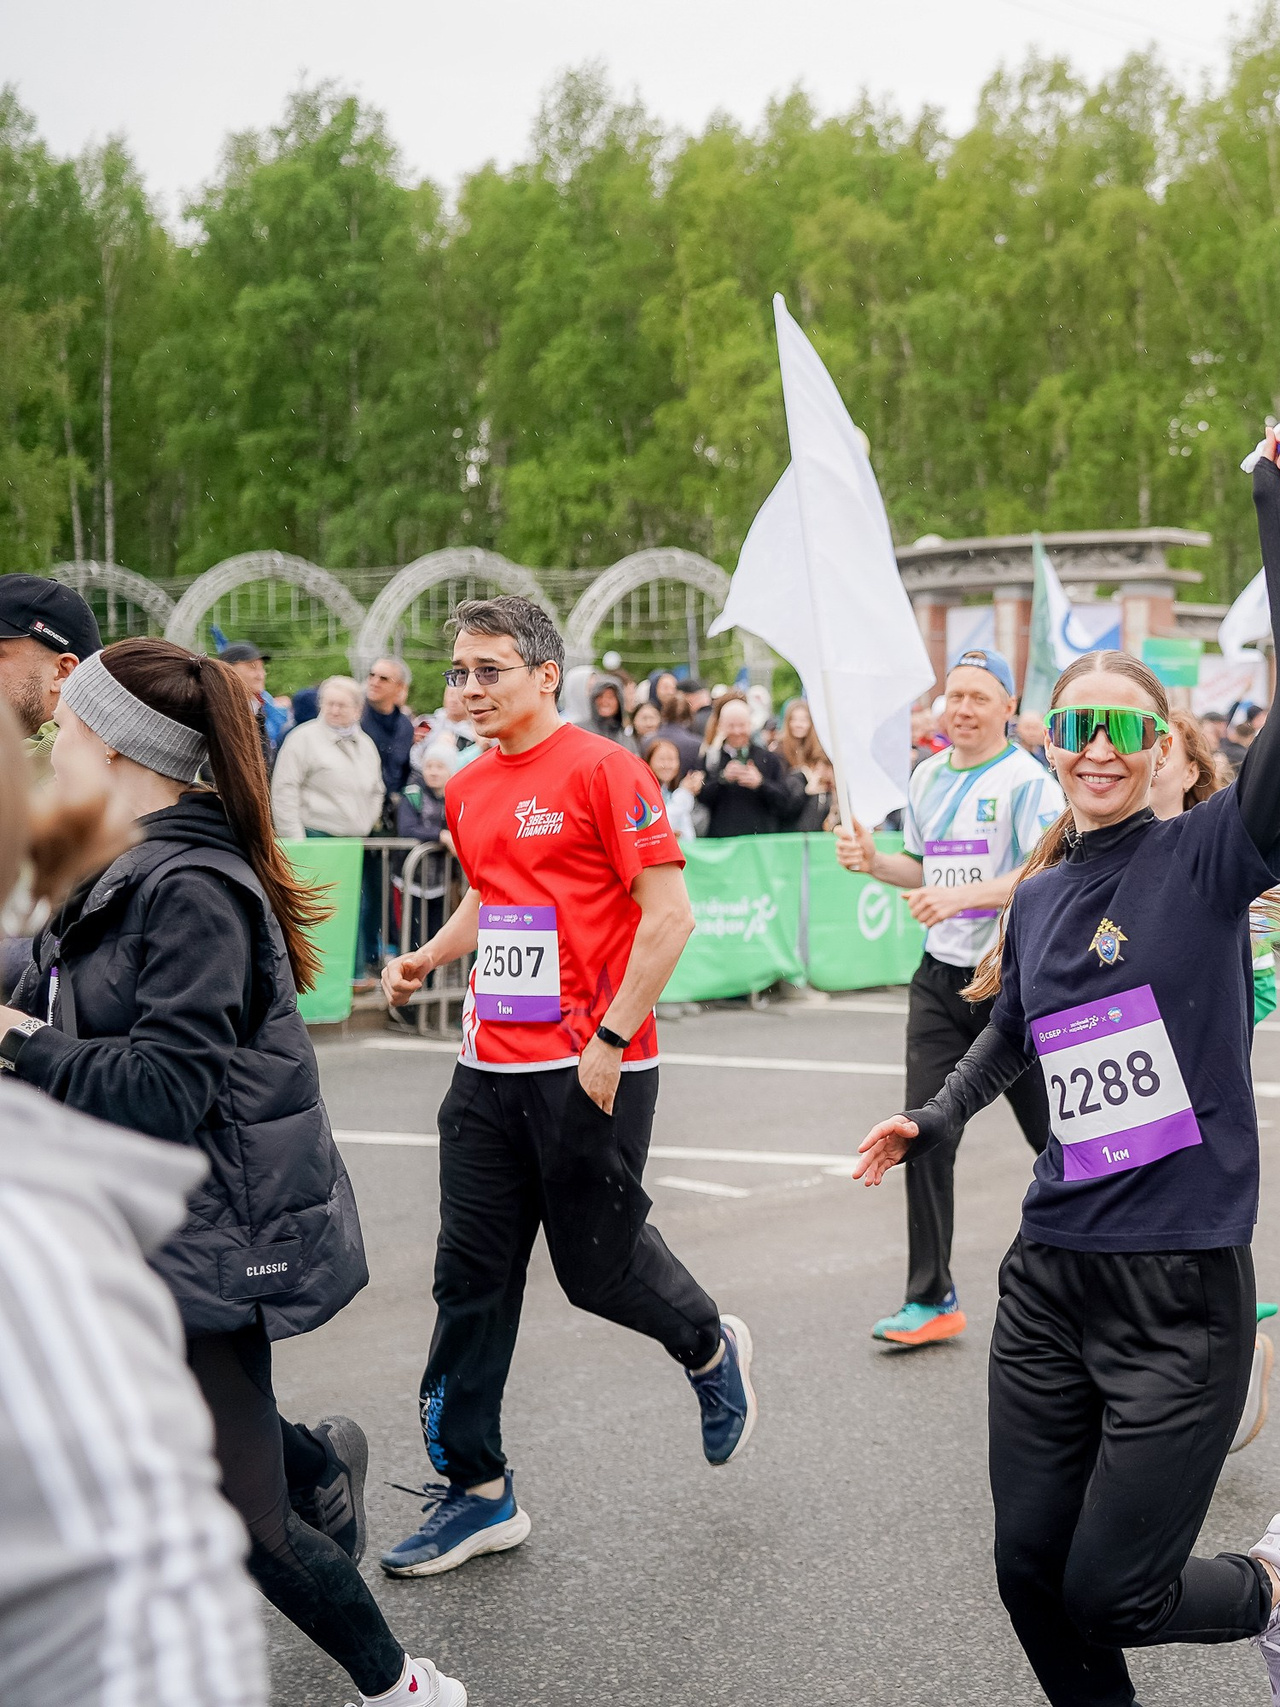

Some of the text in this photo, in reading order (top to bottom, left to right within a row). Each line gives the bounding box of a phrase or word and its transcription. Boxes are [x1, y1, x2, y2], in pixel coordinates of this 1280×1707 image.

[526, 811, 565, 827] ЗВЕЗДА
[520, 822, 563, 839] ПАМЯТИ
[482, 944, 545, 978] 2507
[1044, 1028, 1061, 1039] СБЕР
[1050, 1050, 1161, 1121] 2288
[246, 1261, 288, 1277] CLASSIC
